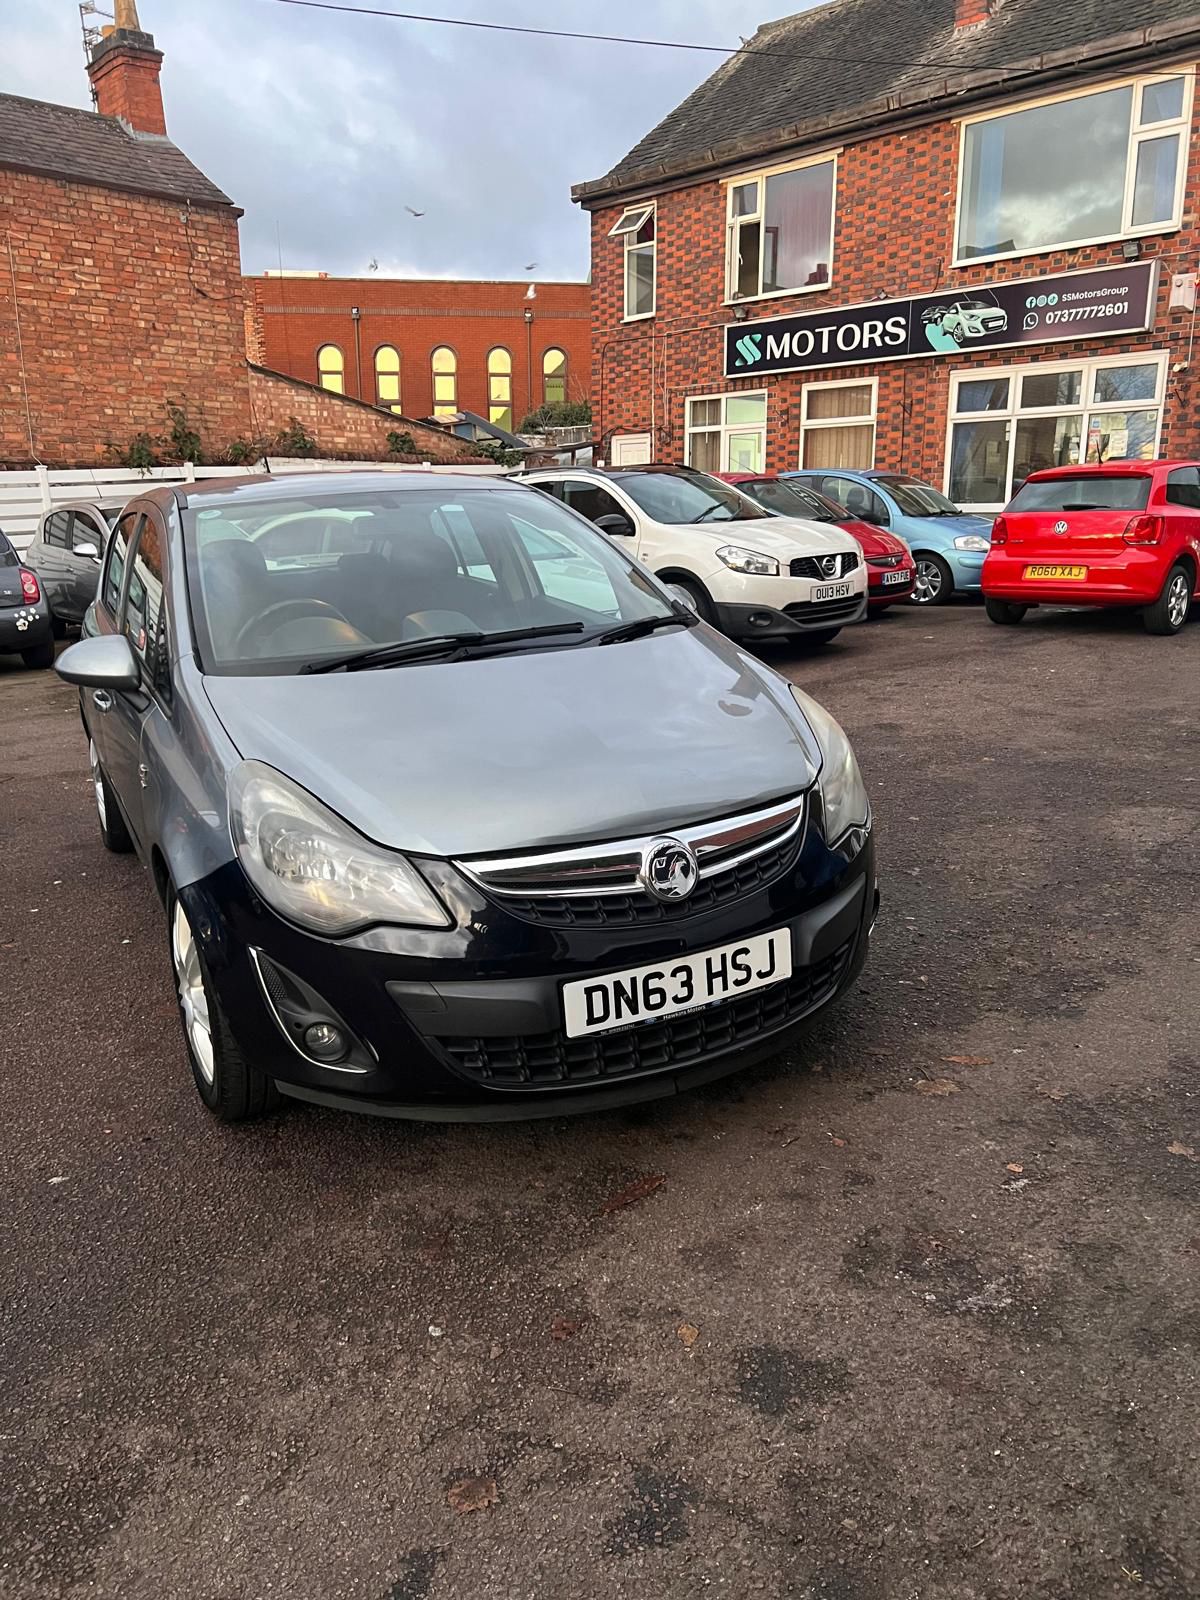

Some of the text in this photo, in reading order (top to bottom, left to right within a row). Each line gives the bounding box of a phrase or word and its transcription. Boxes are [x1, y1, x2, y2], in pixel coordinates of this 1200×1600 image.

[1062, 286, 1129, 302] SSMotorsGroup
[1045, 301, 1129, 325] 07377772601
[766, 316, 907, 361] MOTORS
[816, 584, 850, 600] OU13 HSV
[583, 938, 776, 1027] DN63 HSJ
[687, 1005, 706, 1014] Motors
